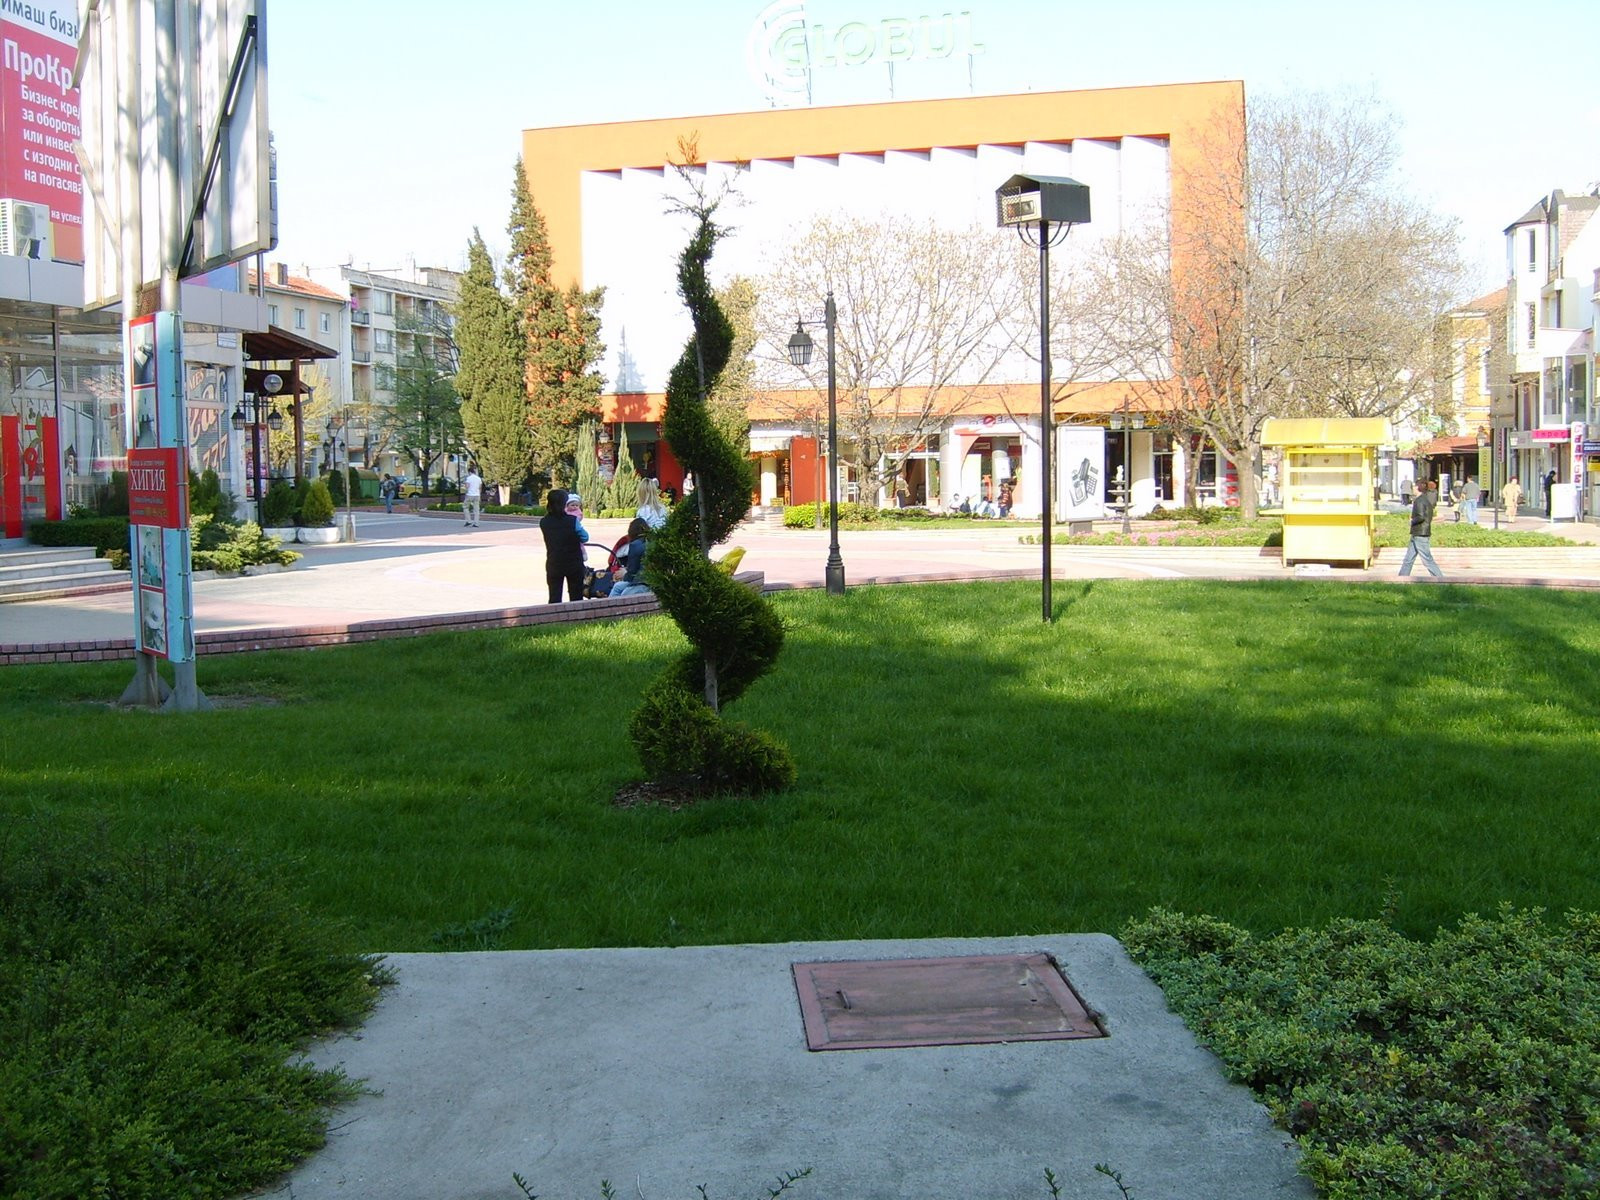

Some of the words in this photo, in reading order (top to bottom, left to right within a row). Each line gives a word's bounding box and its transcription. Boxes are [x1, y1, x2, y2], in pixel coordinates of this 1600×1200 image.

[4, 38, 80, 96] ПроКр
[21, 84, 58, 110] Бизнес
[22, 108, 34, 122] за
[23, 128, 43, 145] или
[23, 149, 30, 161] с
[32, 151, 73, 173] изгодни
[24, 169, 37, 183] на
[130, 468, 166, 492] ХИГИЯ
